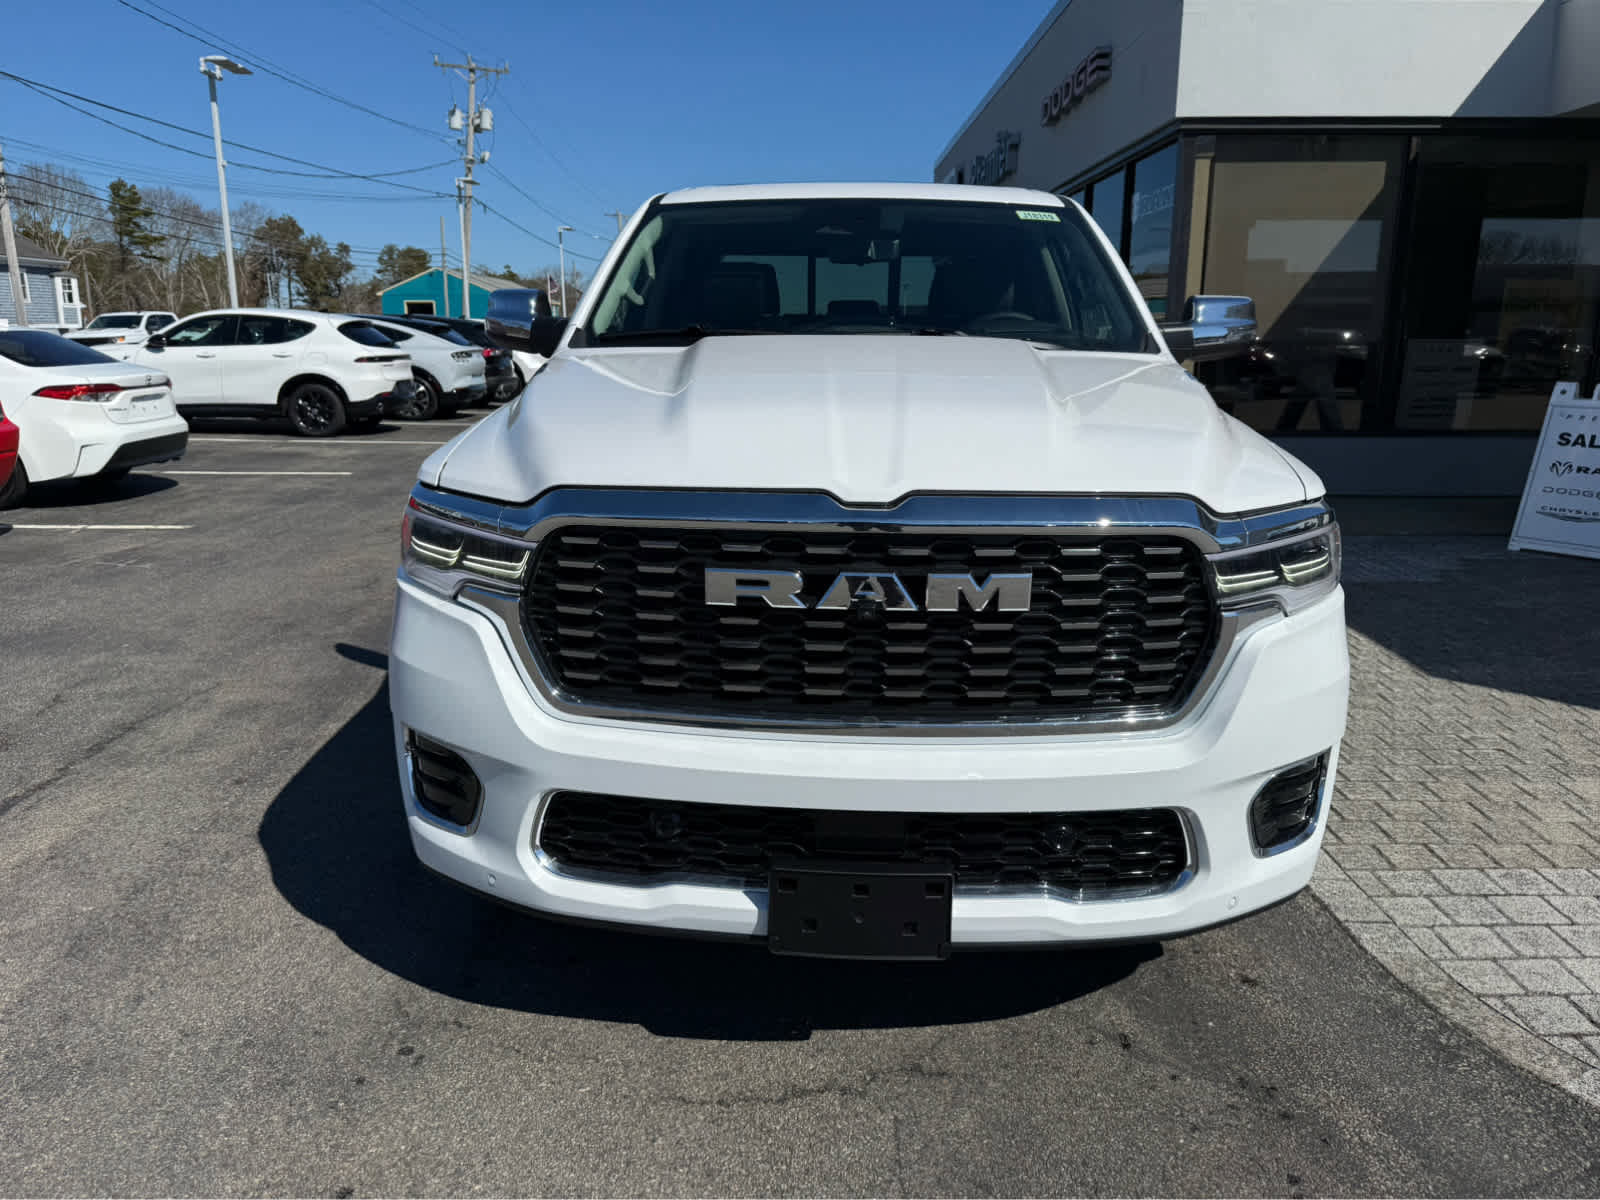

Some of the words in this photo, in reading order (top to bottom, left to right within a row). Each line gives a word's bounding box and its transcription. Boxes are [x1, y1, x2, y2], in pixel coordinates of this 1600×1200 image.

[1041, 46, 1112, 127] DODGE
[1557, 432, 1600, 449] SAL
[705, 567, 1033, 612] RAM
